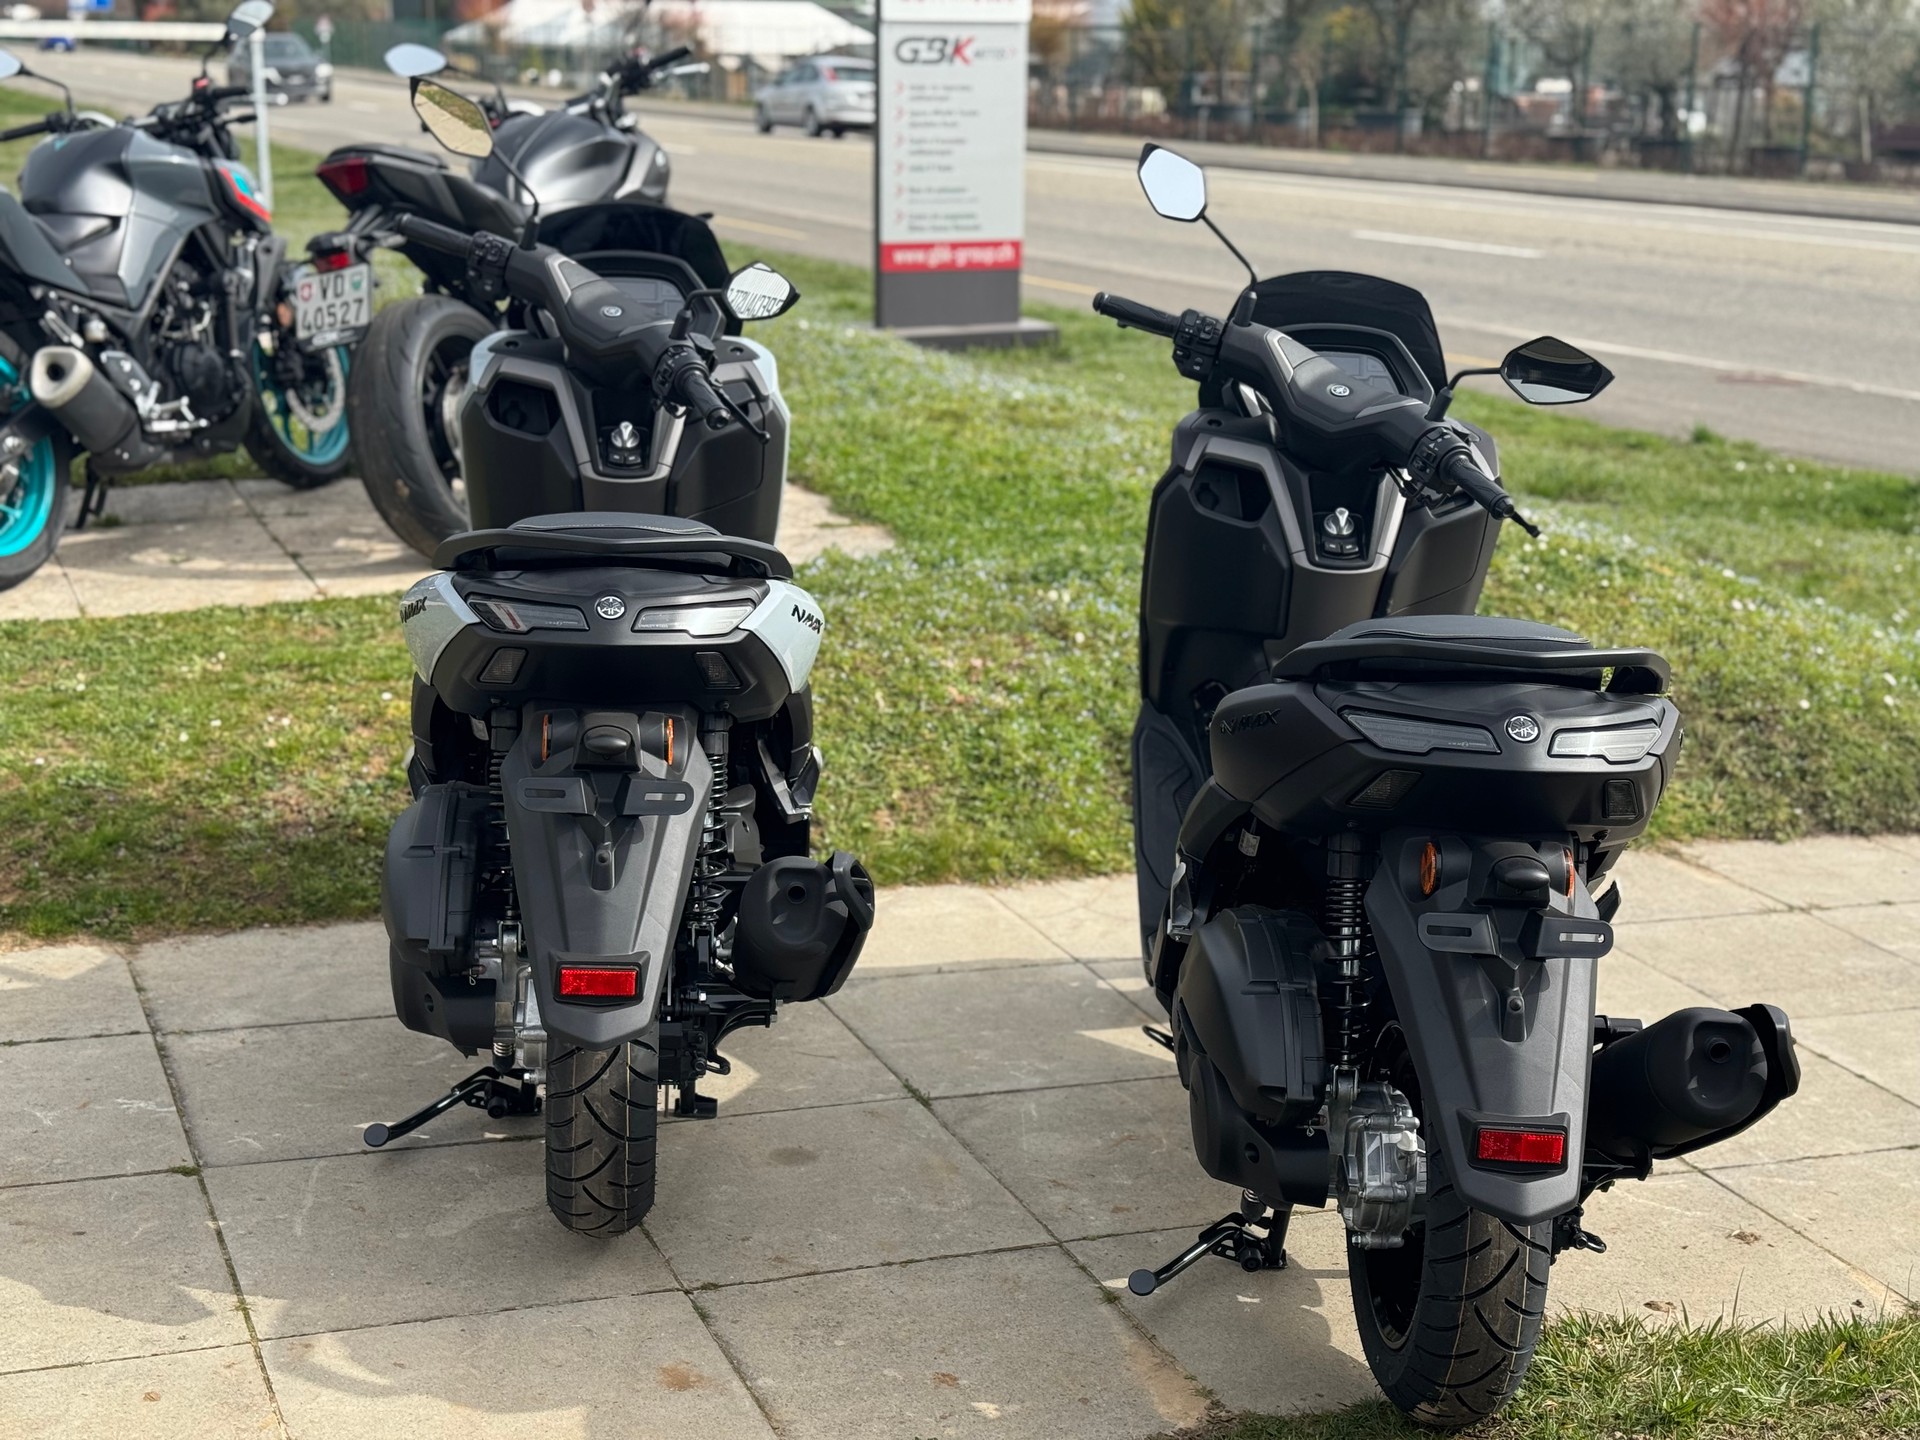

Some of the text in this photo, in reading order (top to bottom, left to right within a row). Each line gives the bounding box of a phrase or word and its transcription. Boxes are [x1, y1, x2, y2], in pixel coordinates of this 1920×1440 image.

[895, 36, 975, 64] GBK
[319, 274, 344, 300] VD
[302, 298, 363, 331] 40527
[400, 596, 427, 623] NMAX
[791, 604, 823, 634] NMAX
[1221, 708, 1280, 735] NMAX
